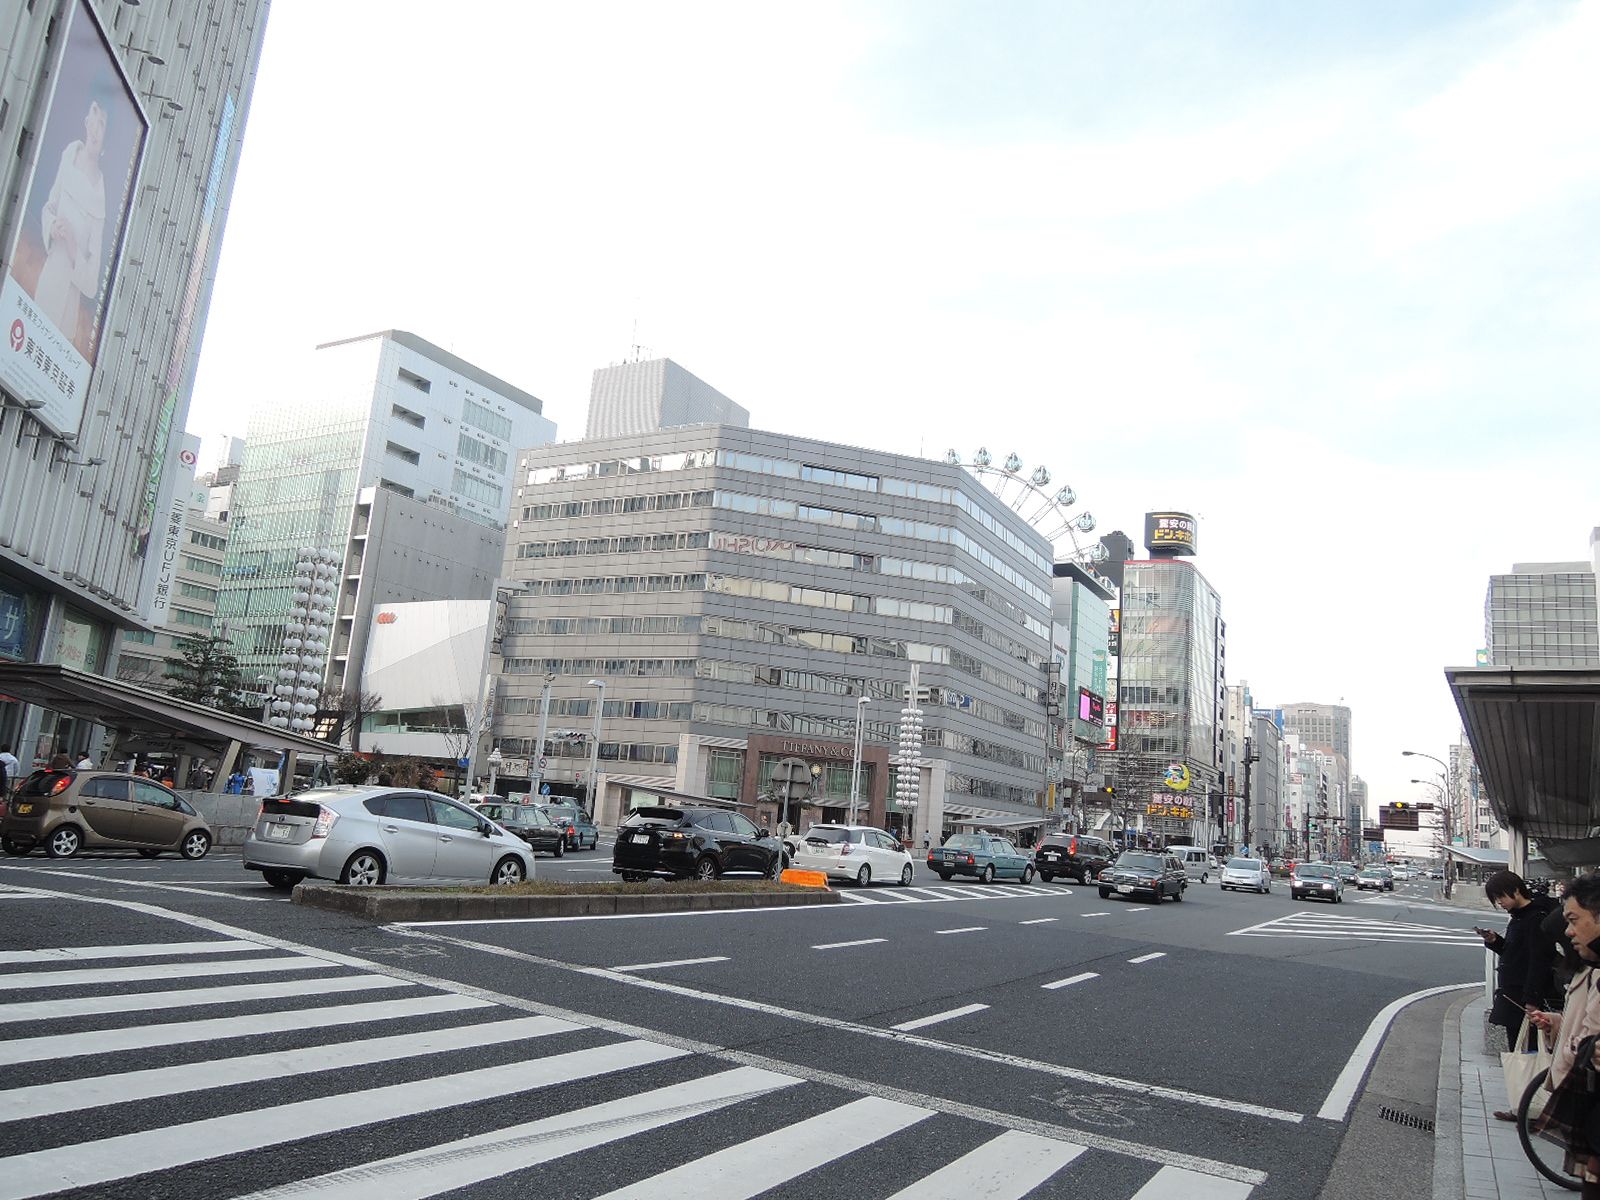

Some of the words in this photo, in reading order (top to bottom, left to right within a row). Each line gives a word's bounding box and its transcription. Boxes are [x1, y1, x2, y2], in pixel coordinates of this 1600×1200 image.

[154, 498, 184, 610] 三菱東京UFJ銀行
[781, 740, 831, 754] TIFFANY
[830, 746, 841, 756] &
